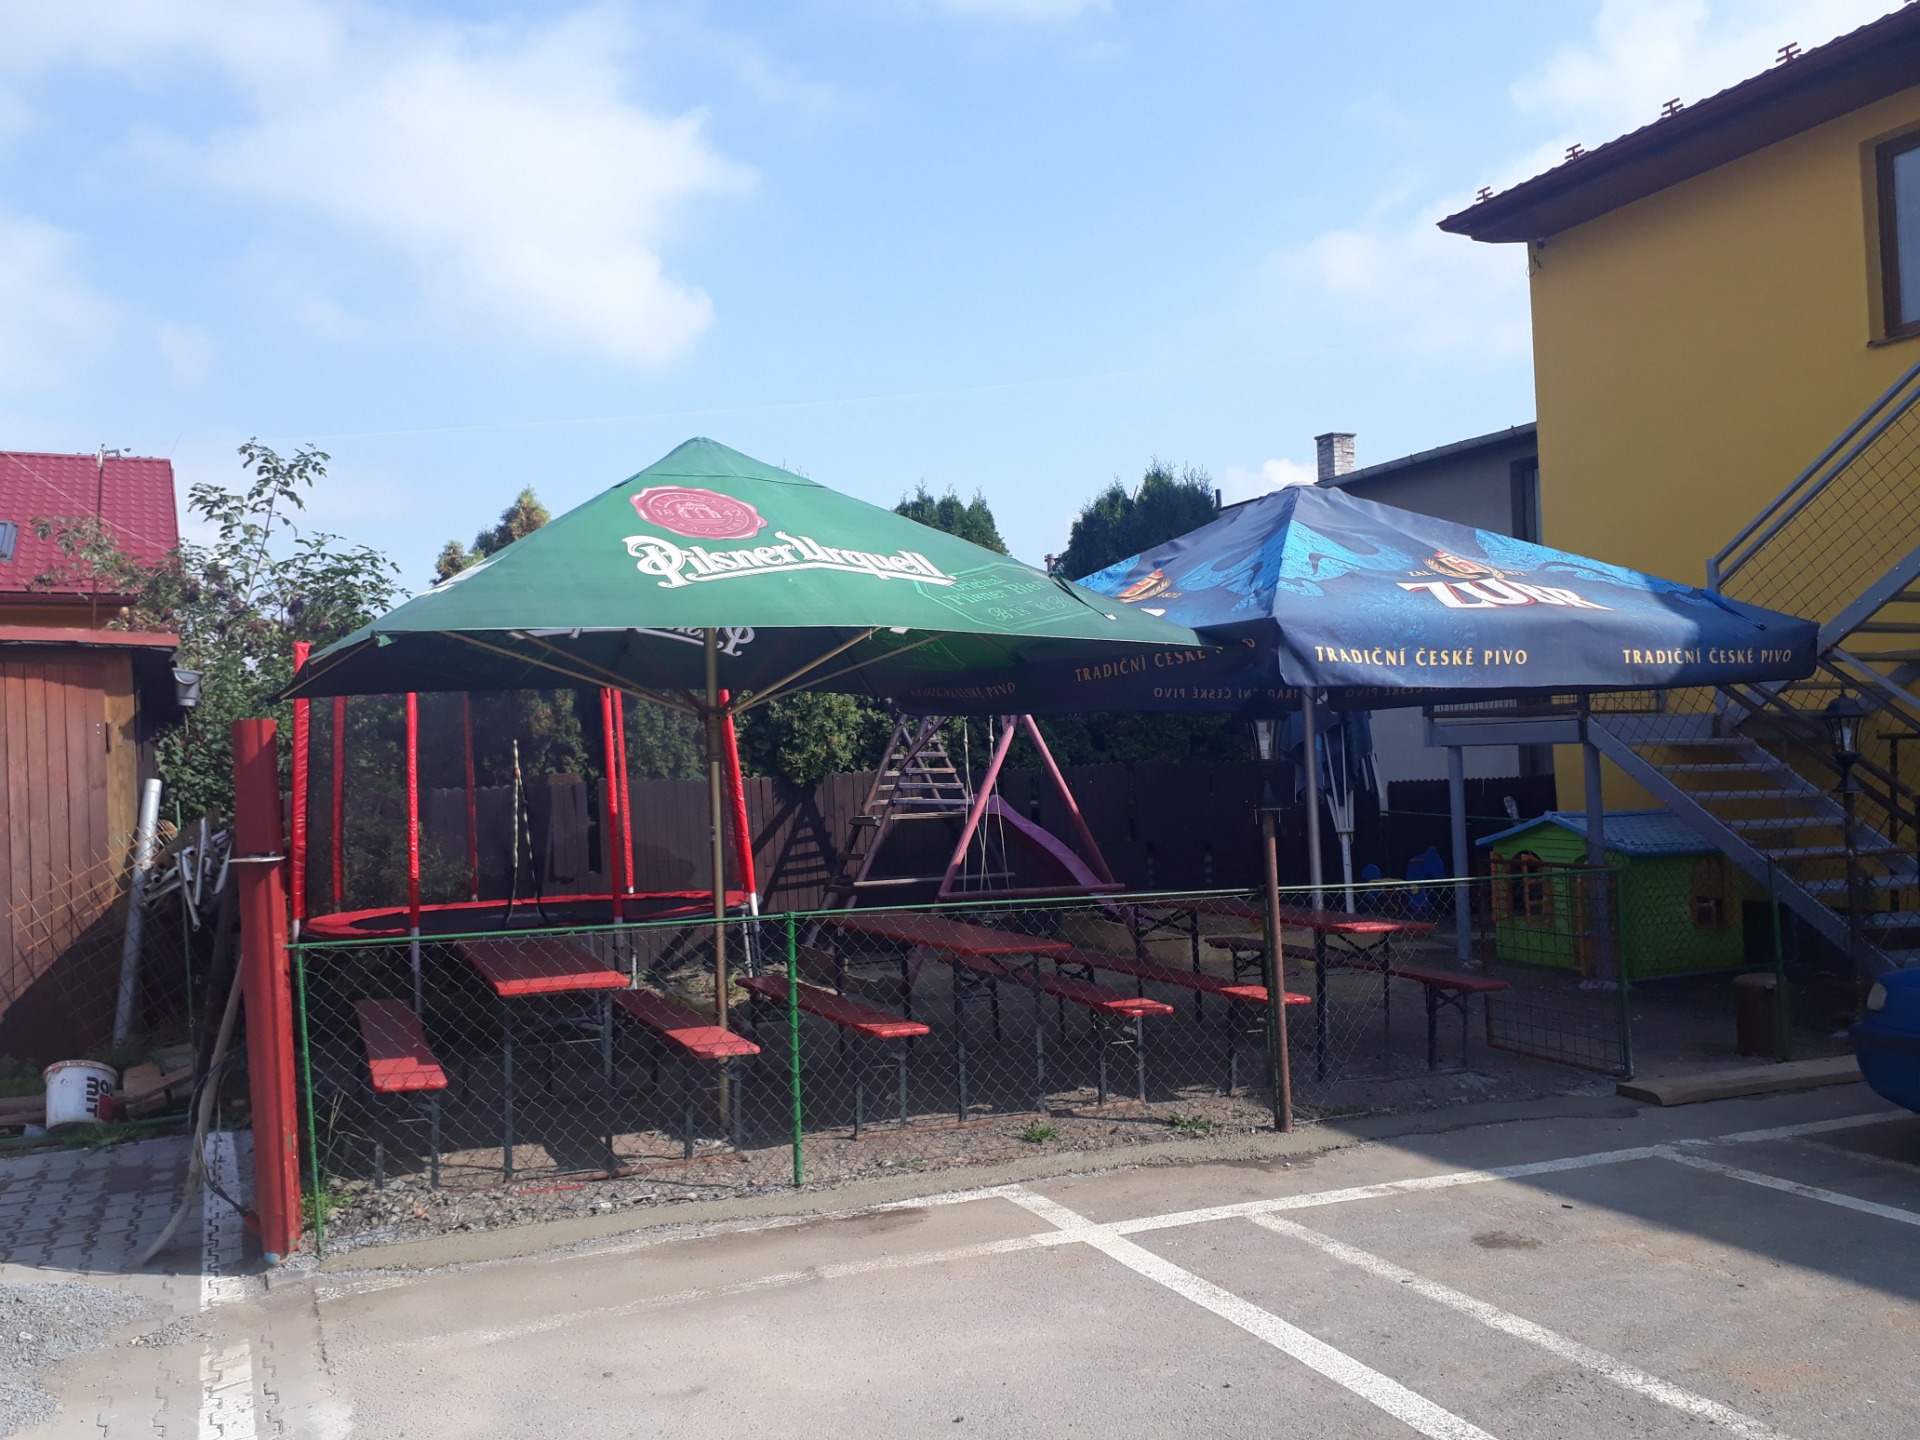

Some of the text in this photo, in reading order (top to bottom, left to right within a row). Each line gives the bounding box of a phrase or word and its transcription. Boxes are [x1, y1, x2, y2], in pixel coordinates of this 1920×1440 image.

[622, 531, 957, 588] Pilsner Urquell
[1395, 577, 1616, 612] ZUBR
[1074, 654, 1147, 683] TRADIČNÍ
[1314, 646, 1528, 666] TRADIČNÍ ČESKÉ PIVO
[1622, 647, 1792, 664] TRADIČNÍ ČESKÉ PIVO
